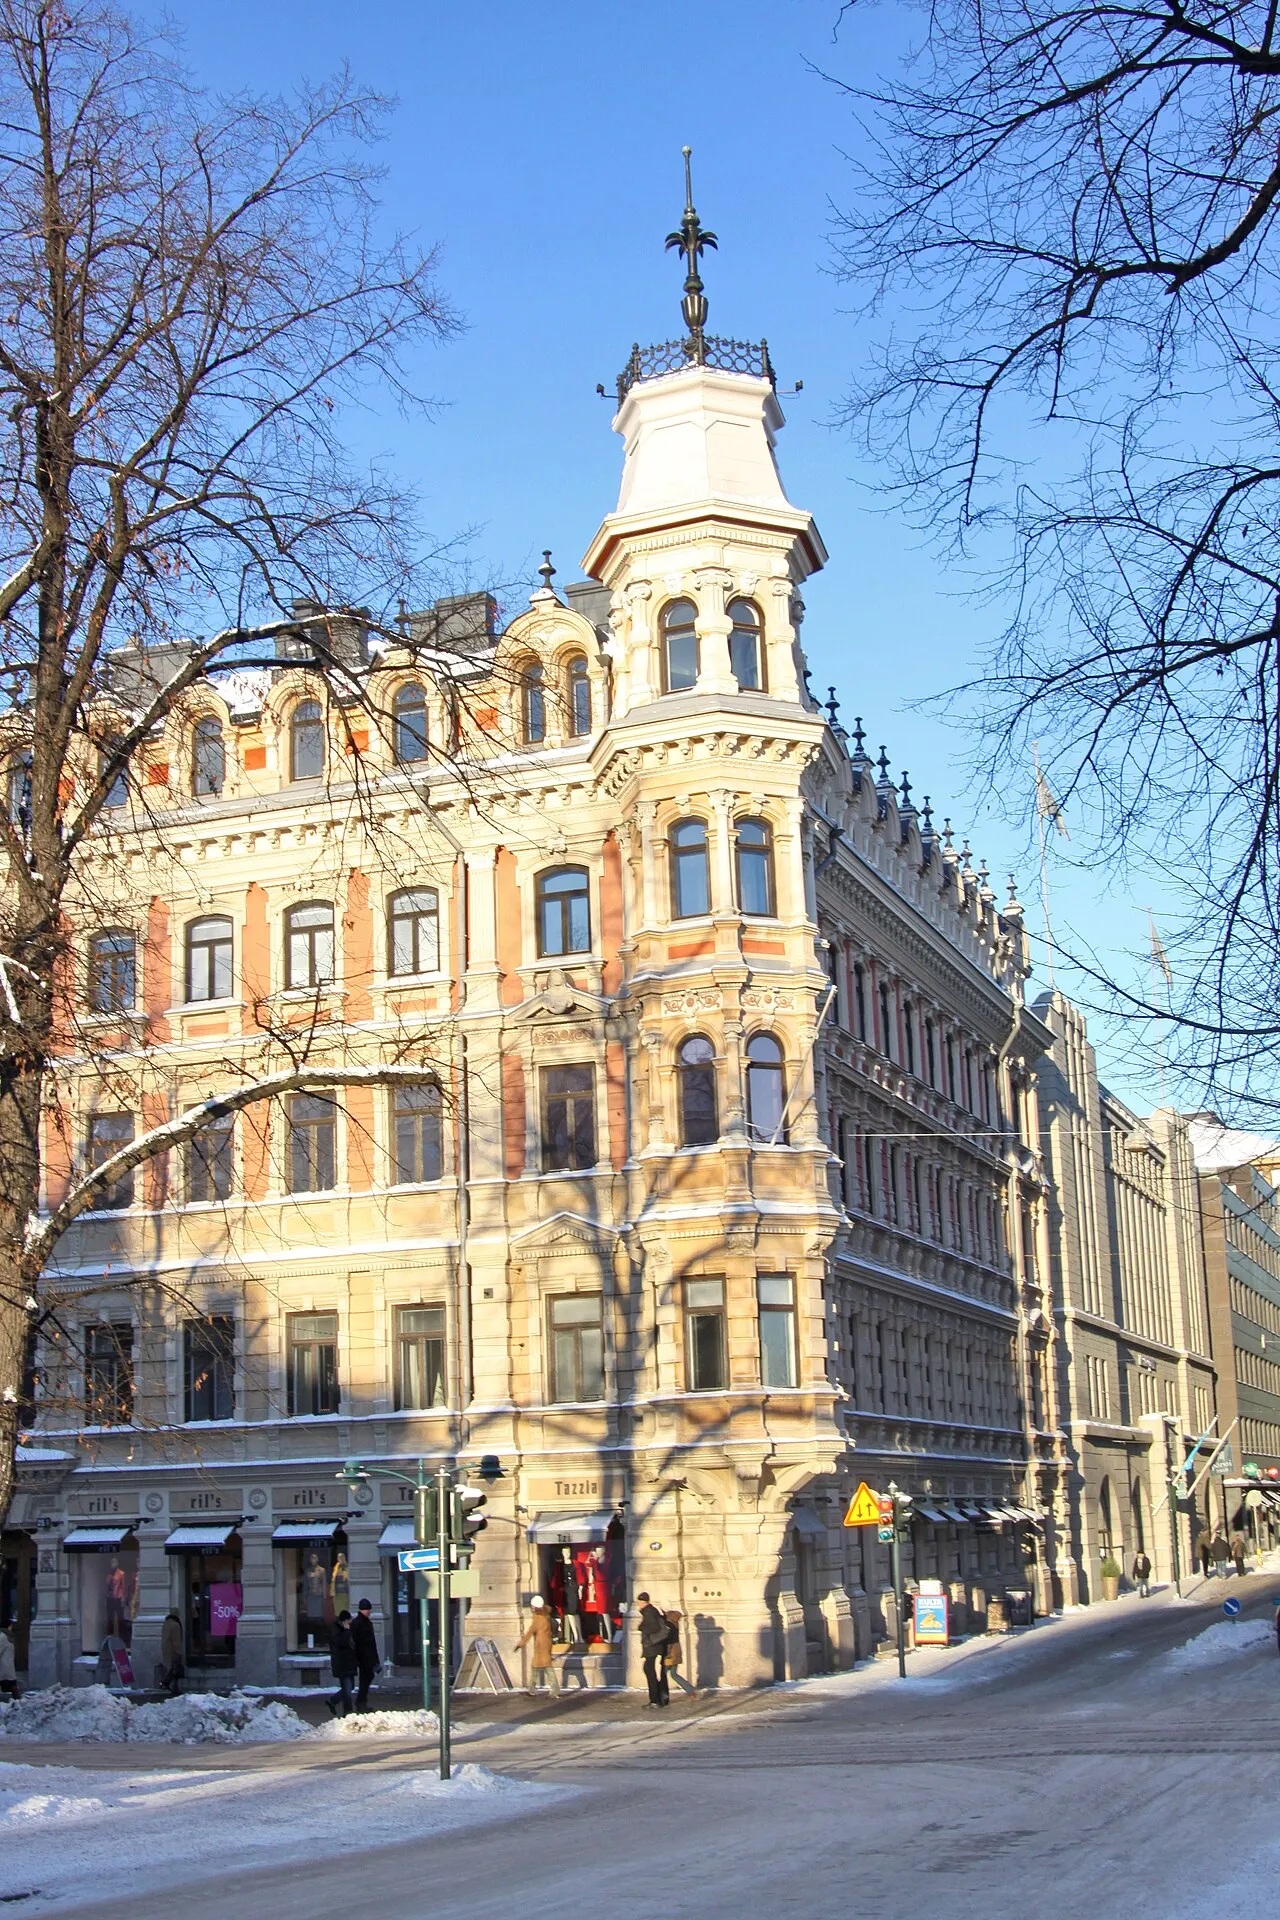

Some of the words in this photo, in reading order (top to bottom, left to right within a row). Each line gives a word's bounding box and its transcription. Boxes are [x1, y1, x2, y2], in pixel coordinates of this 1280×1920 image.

[554, 1480, 598, 1496] Tazzia
[88, 1497, 119, 1512] ril's
[190, 1493, 222, 1509] ril's
[293, 1489, 326, 1505] ril's
[213, 1606, 240, 1618] -50%
